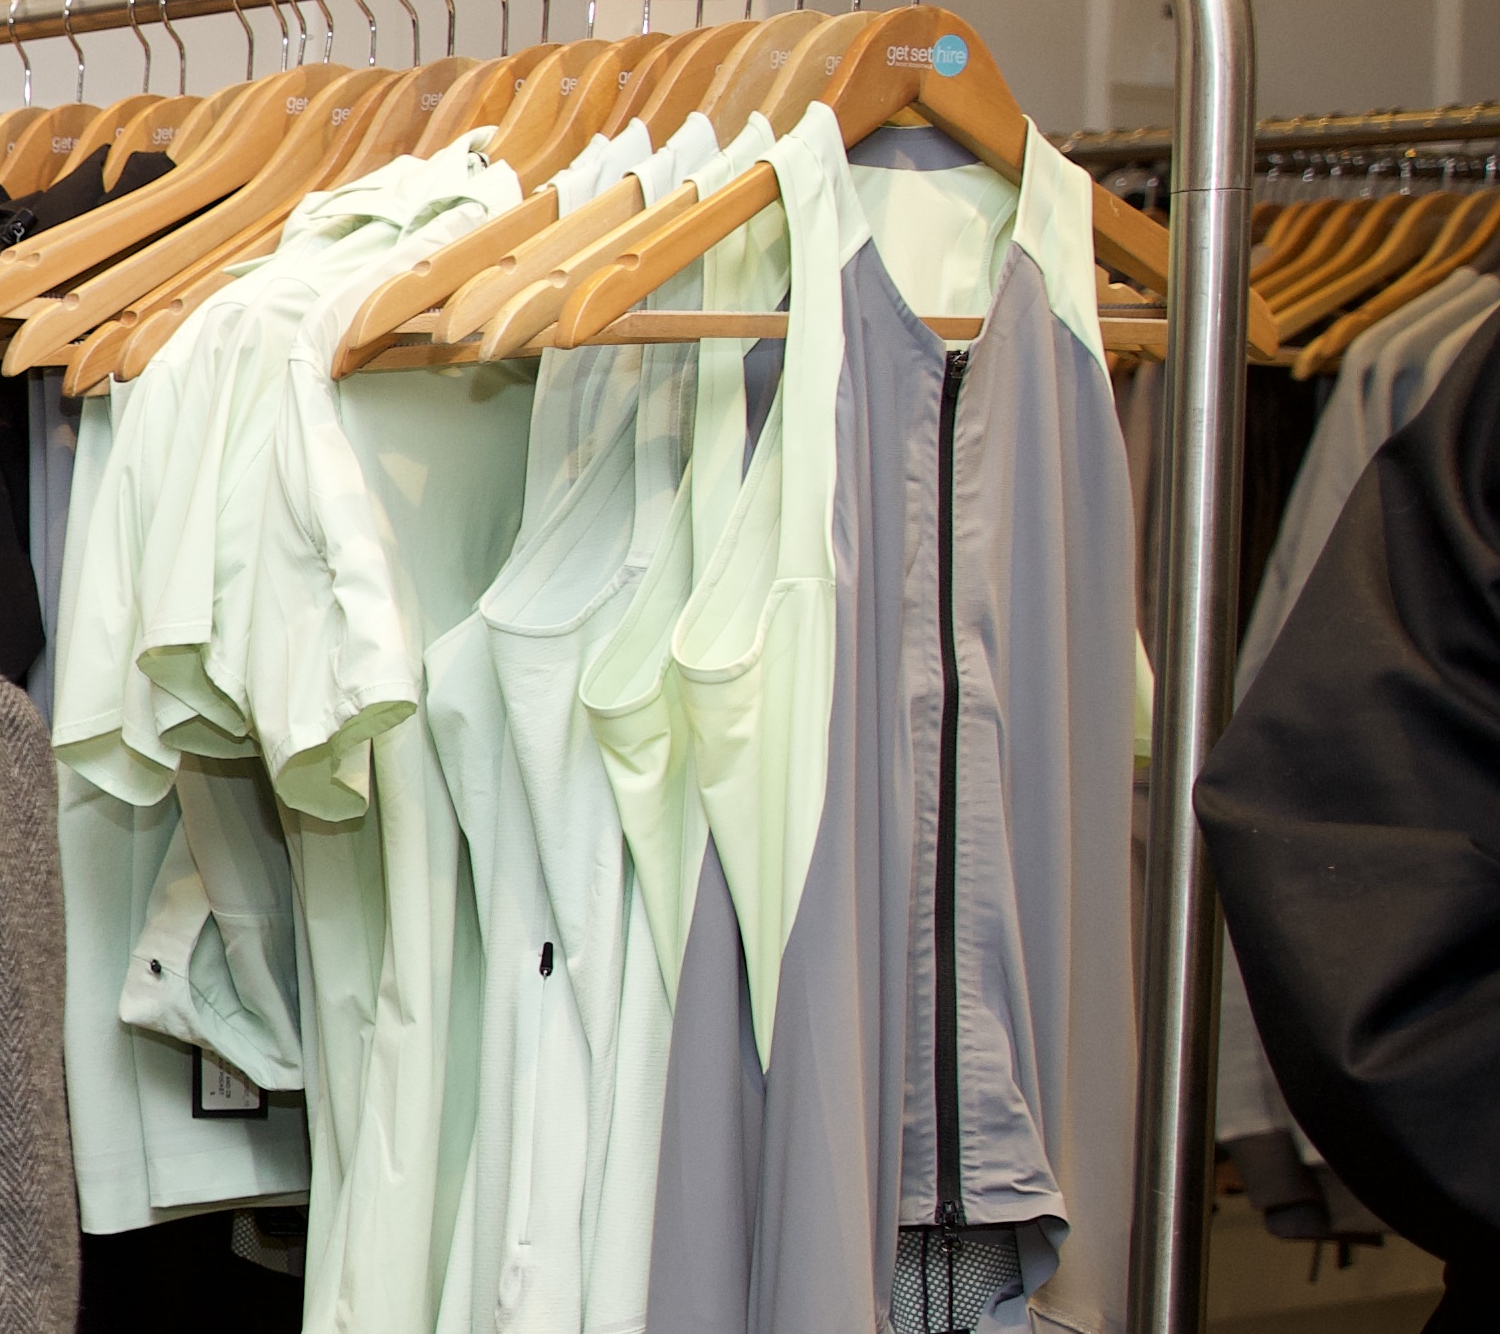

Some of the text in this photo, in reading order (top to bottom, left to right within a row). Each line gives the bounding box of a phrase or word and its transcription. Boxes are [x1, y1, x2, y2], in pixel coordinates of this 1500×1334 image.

[886, 45, 966, 66] get set hire
[560, 77, 577, 95] ge
[286, 97, 309, 114] get
[332, 108, 353, 125] ge
[152, 127, 173, 144] get
[51, 136, 72, 153] get
